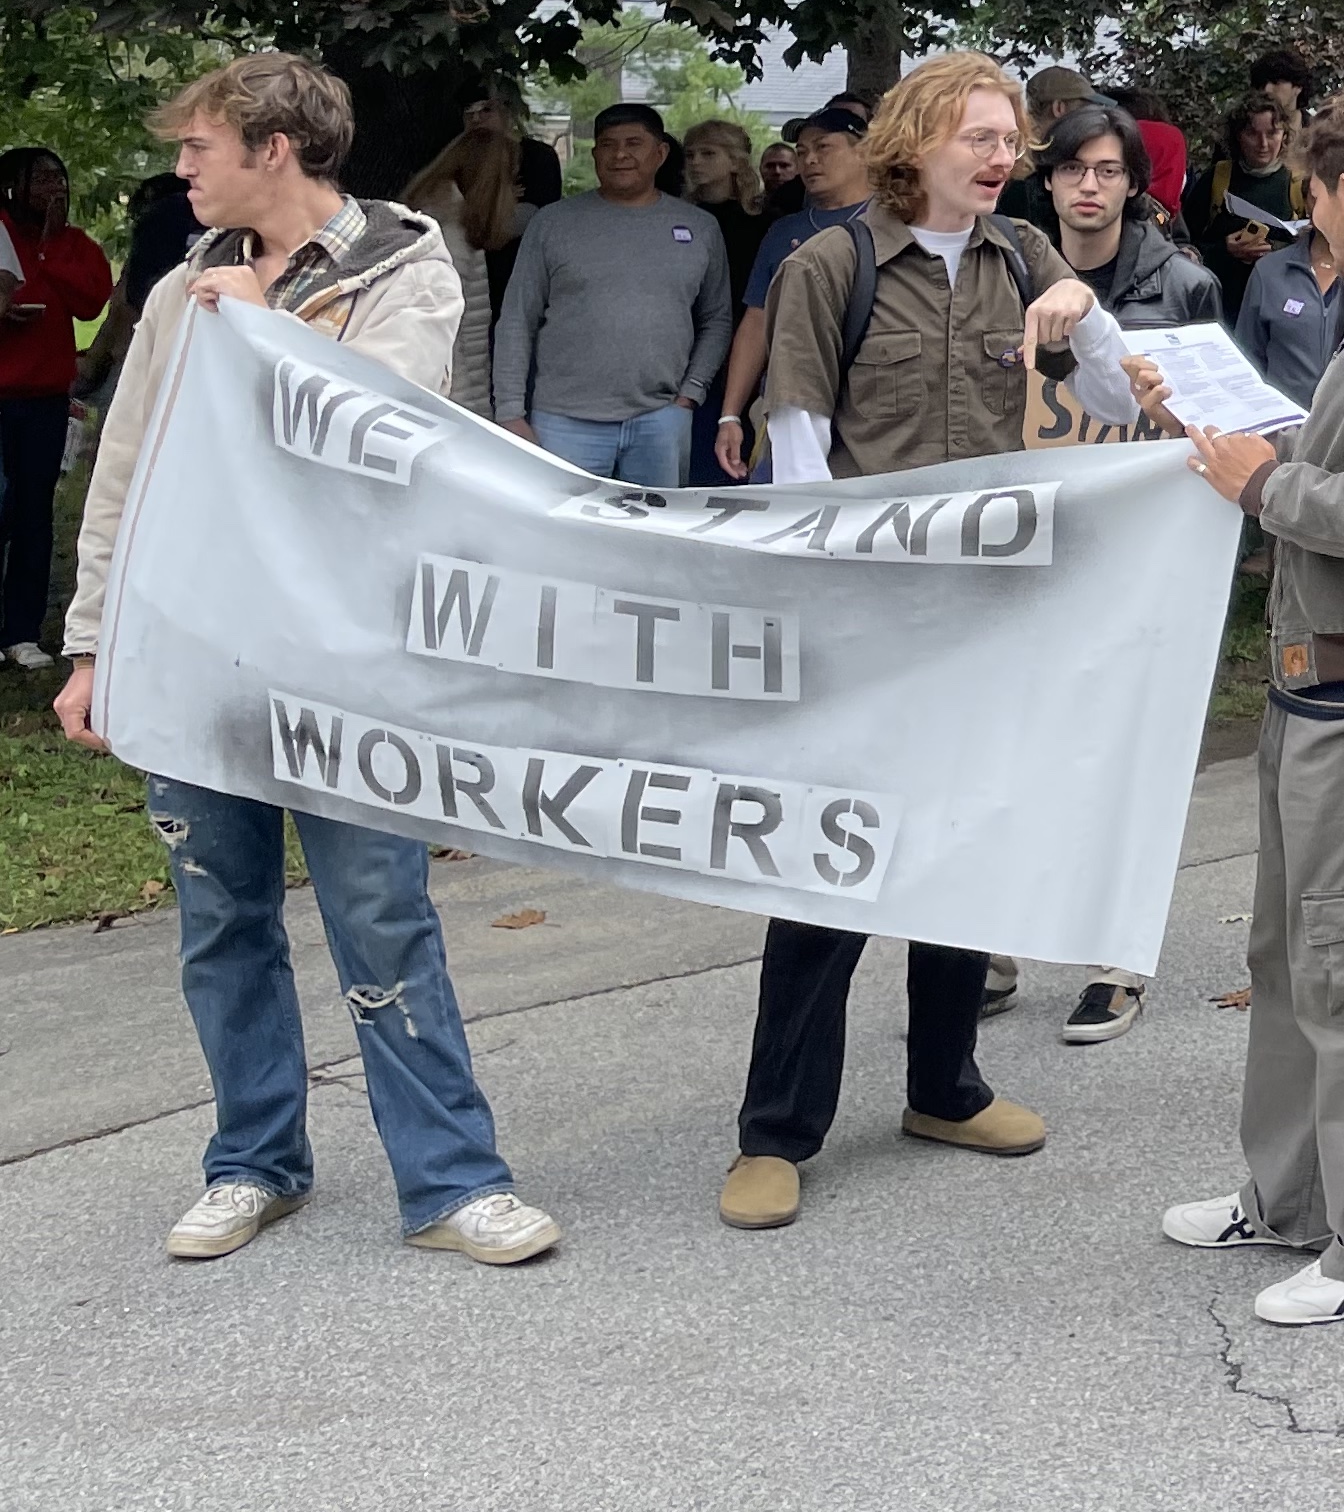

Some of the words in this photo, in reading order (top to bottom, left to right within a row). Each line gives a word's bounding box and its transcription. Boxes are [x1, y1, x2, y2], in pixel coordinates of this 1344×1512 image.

[278, 361, 434, 474] WE
[582, 490, 1038, 559] STAND
[421, 560, 786, 695] WITH
[273, 696, 881, 888] WORKERS
